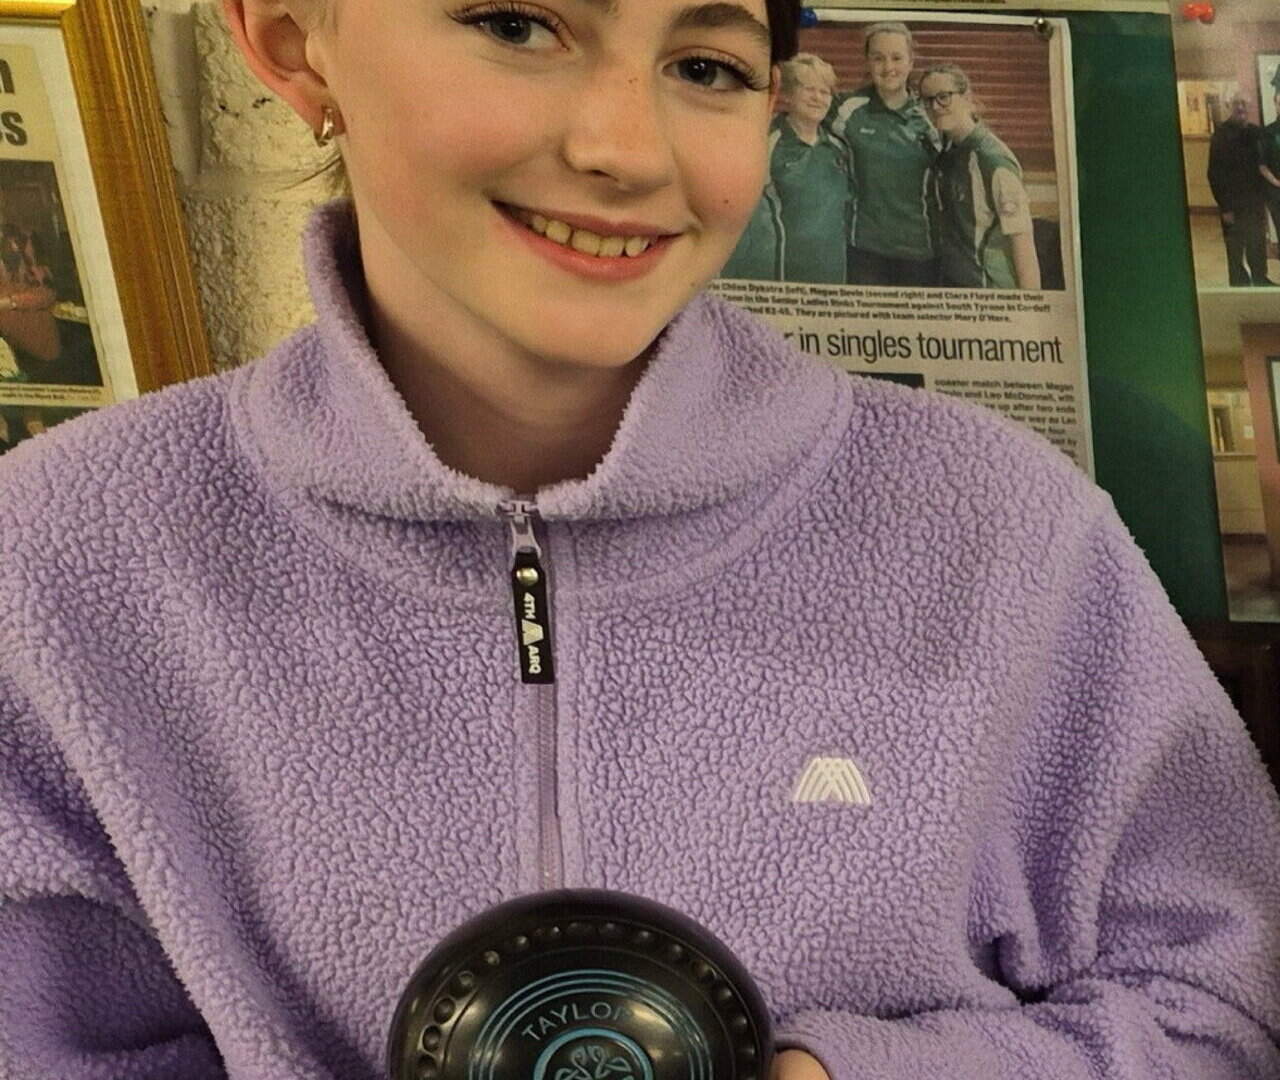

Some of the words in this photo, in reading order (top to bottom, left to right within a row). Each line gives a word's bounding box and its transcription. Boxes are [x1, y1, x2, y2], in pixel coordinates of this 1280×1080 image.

[799, 327, 820, 354] in
[826, 328, 912, 364] singles
[916, 331, 1064, 364] tournament
[528, 645, 541, 674] ARQ
